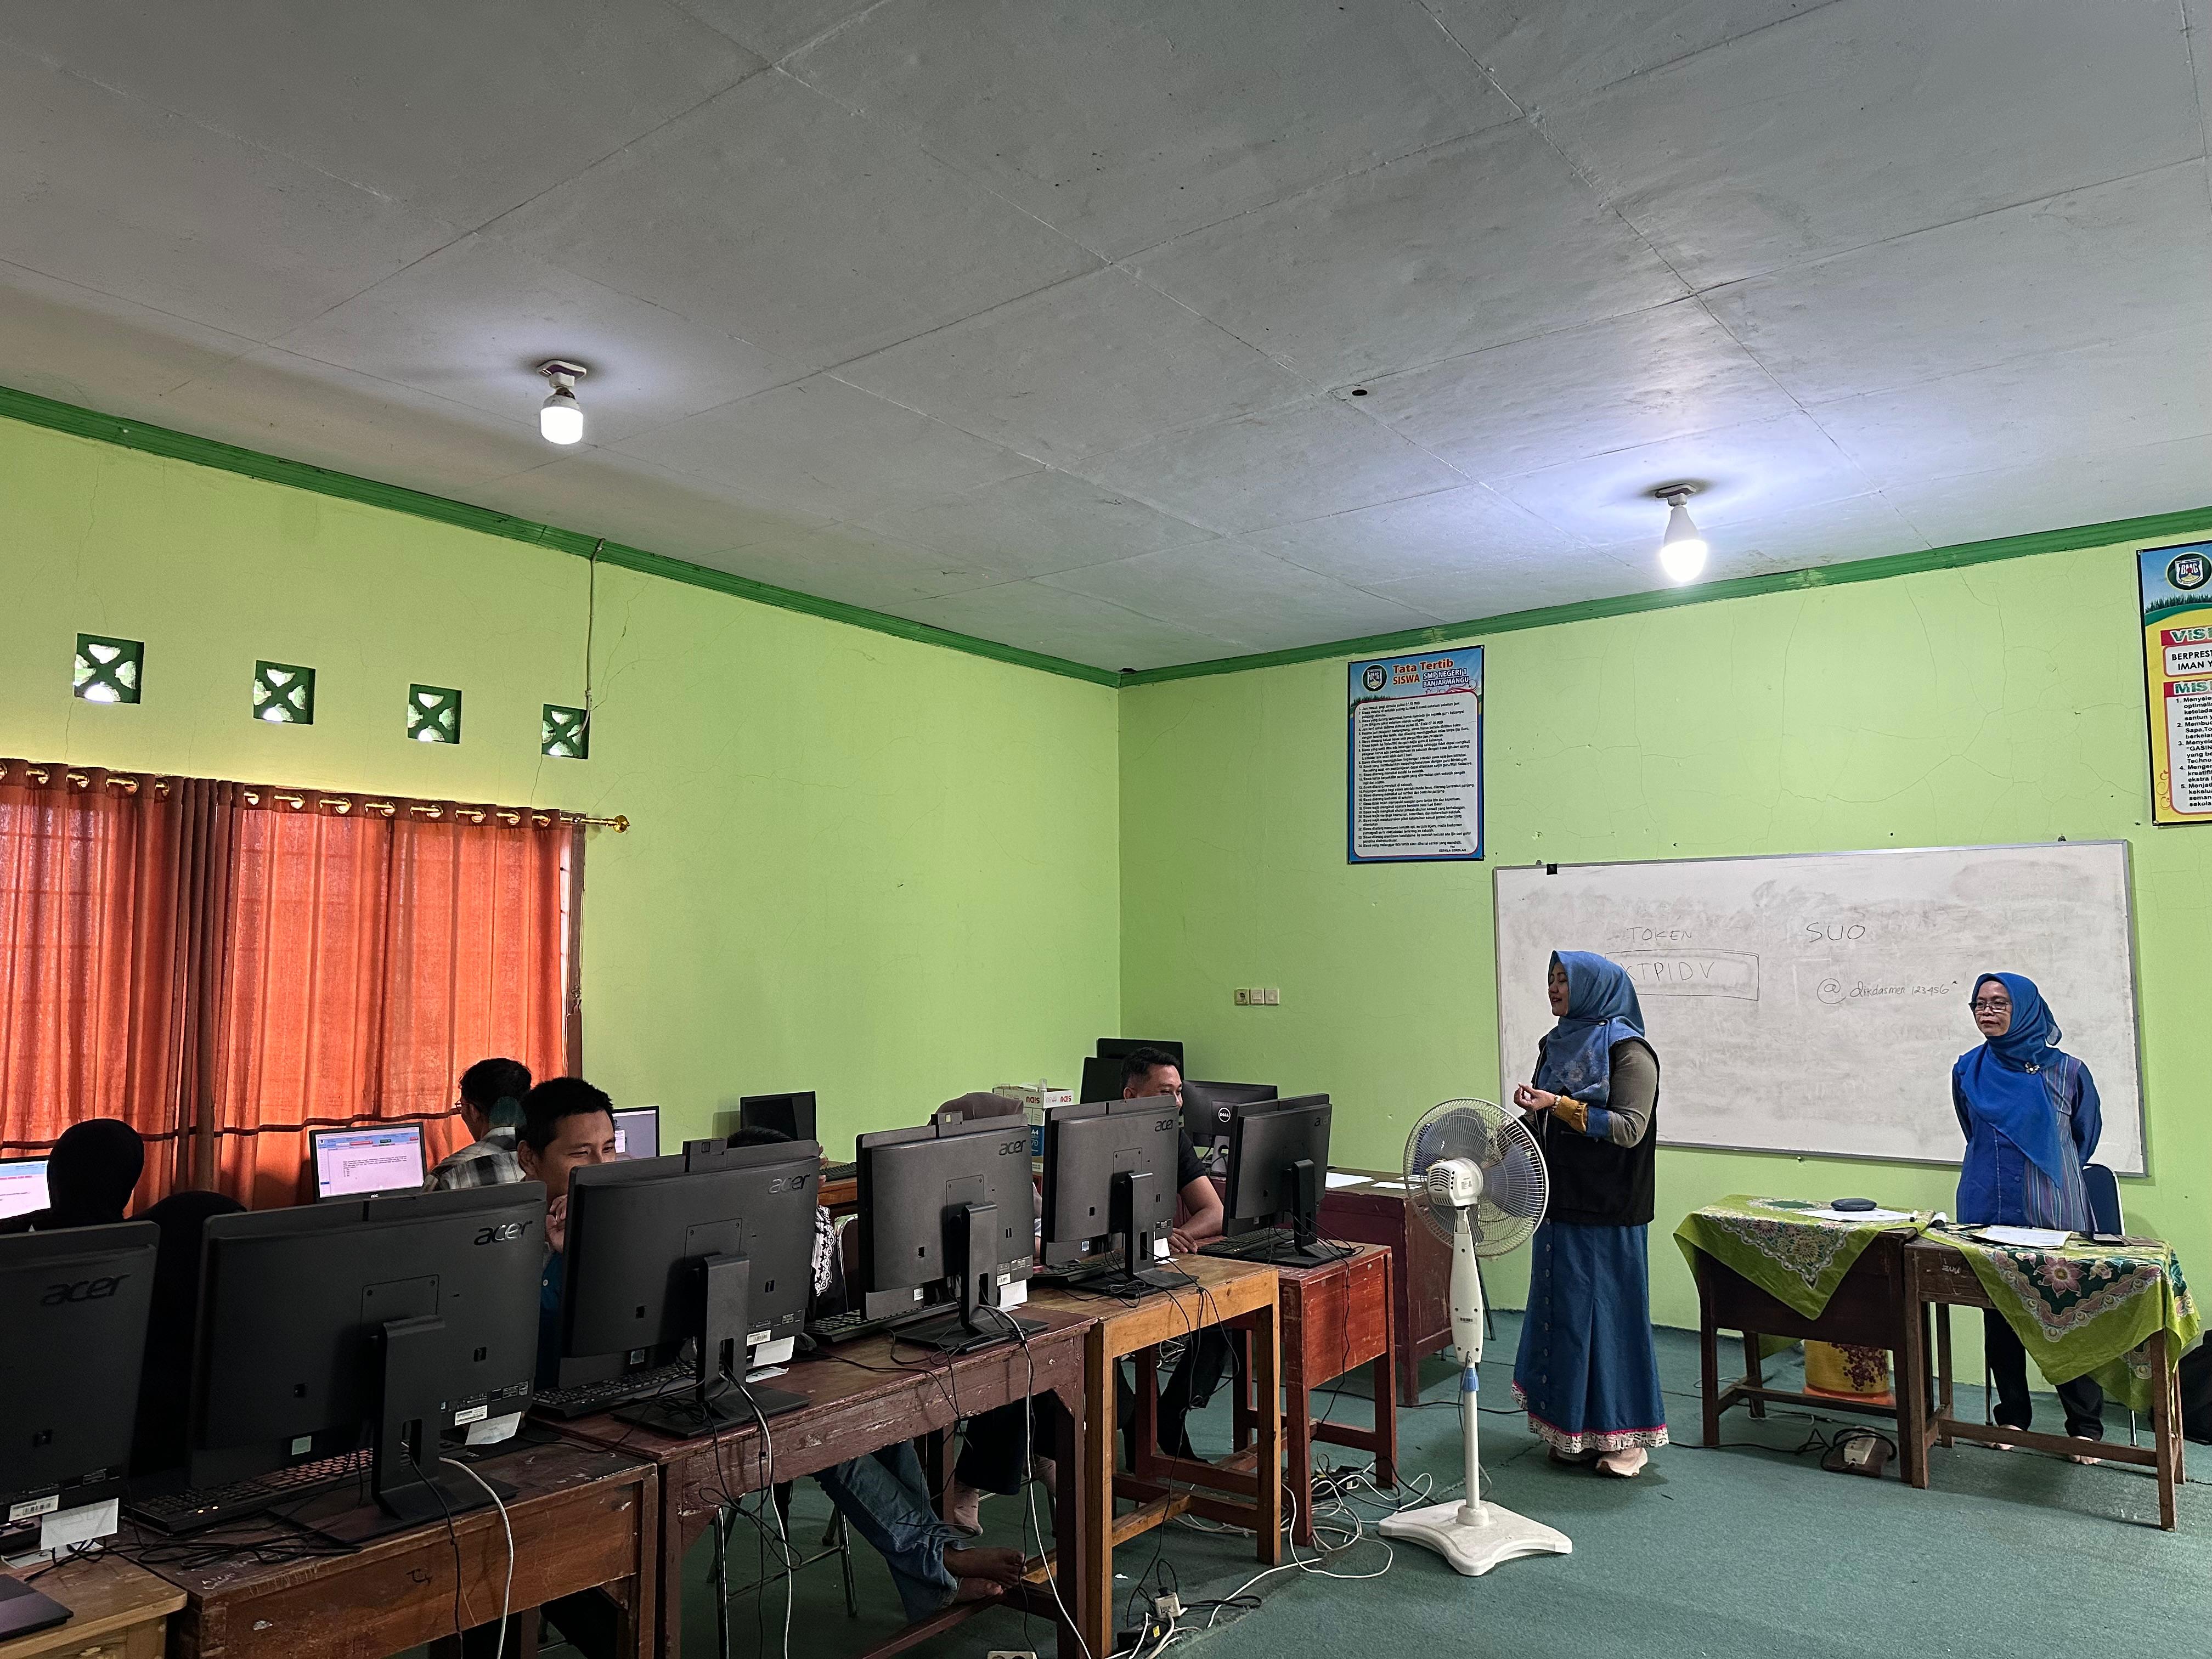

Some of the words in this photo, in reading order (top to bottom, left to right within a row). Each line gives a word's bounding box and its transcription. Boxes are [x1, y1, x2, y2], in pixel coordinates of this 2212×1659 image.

[1393, 664, 1417, 674] Tata
[1419, 658, 1453, 671] Tertib
[2178, 661, 2204, 670] IMAN
[1393, 674, 1420, 685] SISWA
[1423, 671, 1437, 680] SMP
[1438, 669, 1462, 678] NEGERI
[1423, 676, 1469, 687] BANJARMANGU
[1627, 927, 1692, 943] TOKEN
[1807, 922, 1865, 943] SUO
[999, 1139, 1026, 1156] acer
[769, 1174, 810, 1194] acer
[474, 1221, 533, 1245] acer
[41, 1273, 132, 1306] acer
